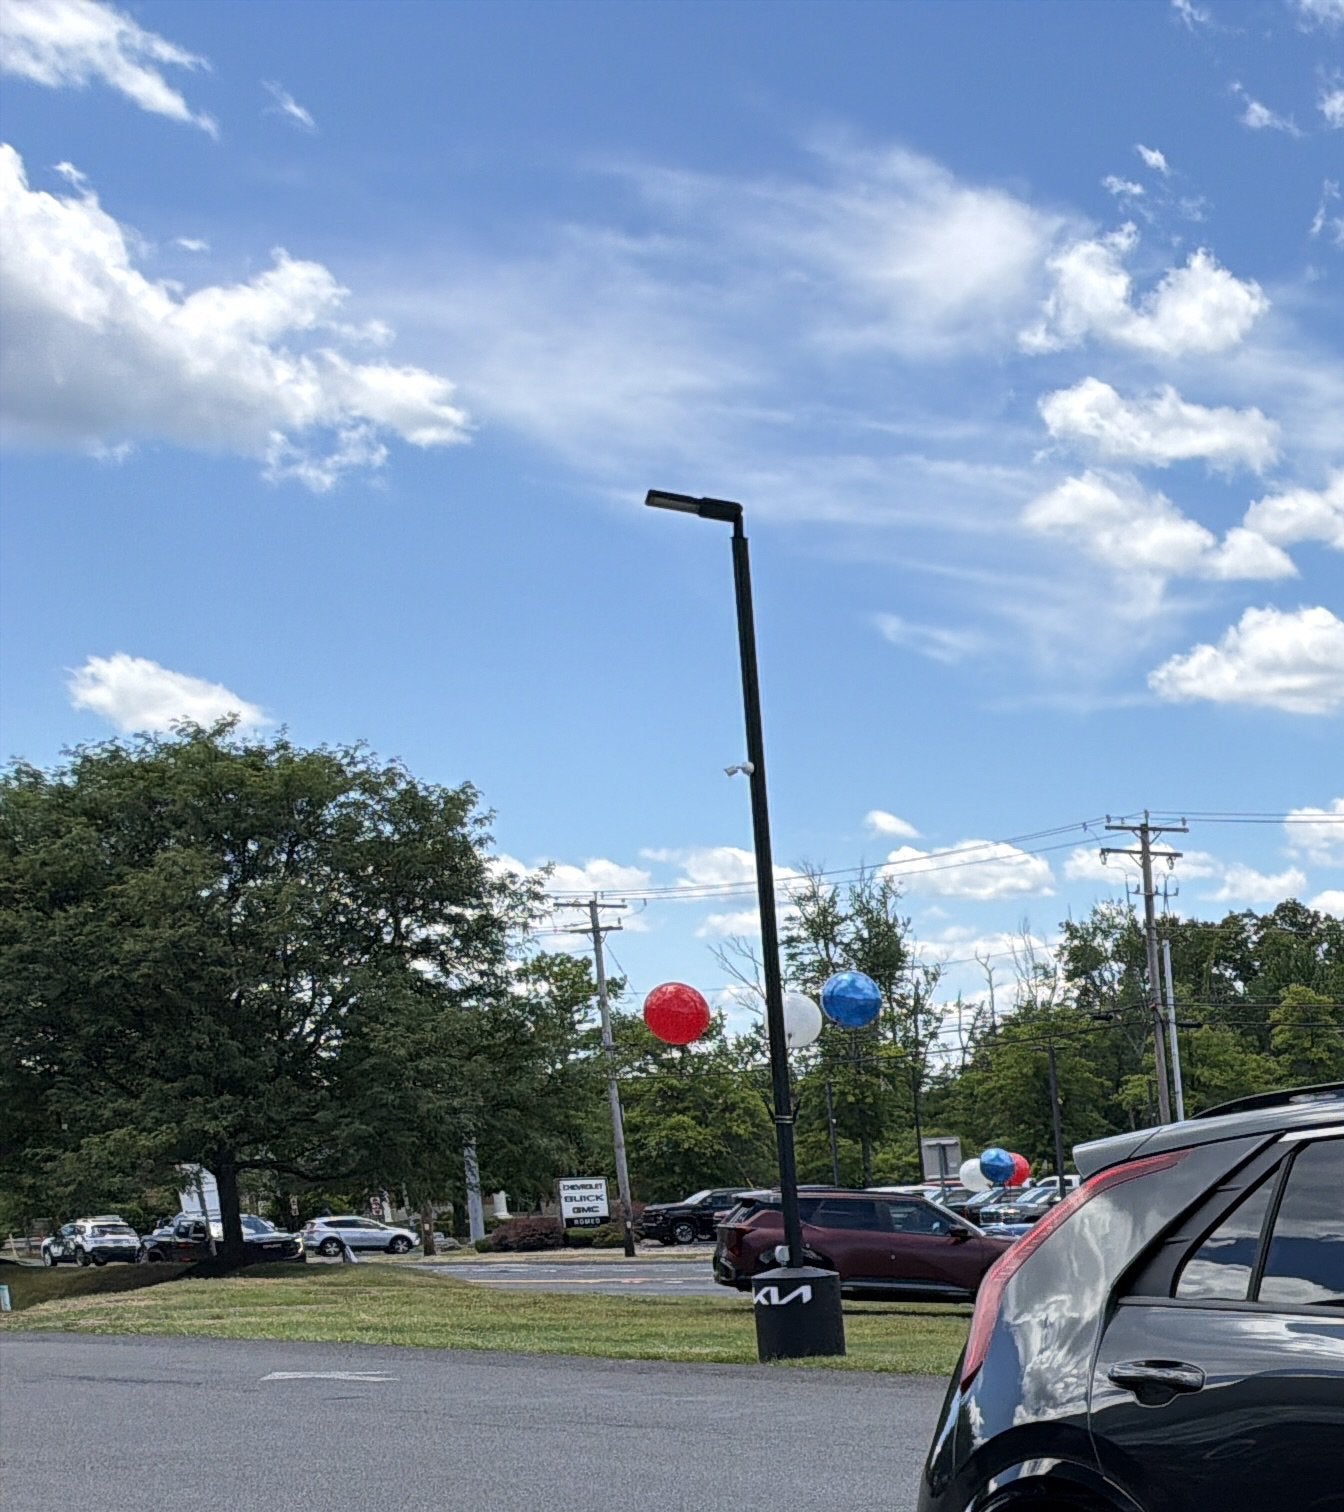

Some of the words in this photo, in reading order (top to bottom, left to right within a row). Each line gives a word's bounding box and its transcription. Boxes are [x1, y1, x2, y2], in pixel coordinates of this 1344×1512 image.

[564, 1194, 605, 1202] BUICK
[572, 1205, 600, 1214] GMC
[573, 1217, 601, 1226] ROMEO
[752, 1285, 813, 1306] KIA
